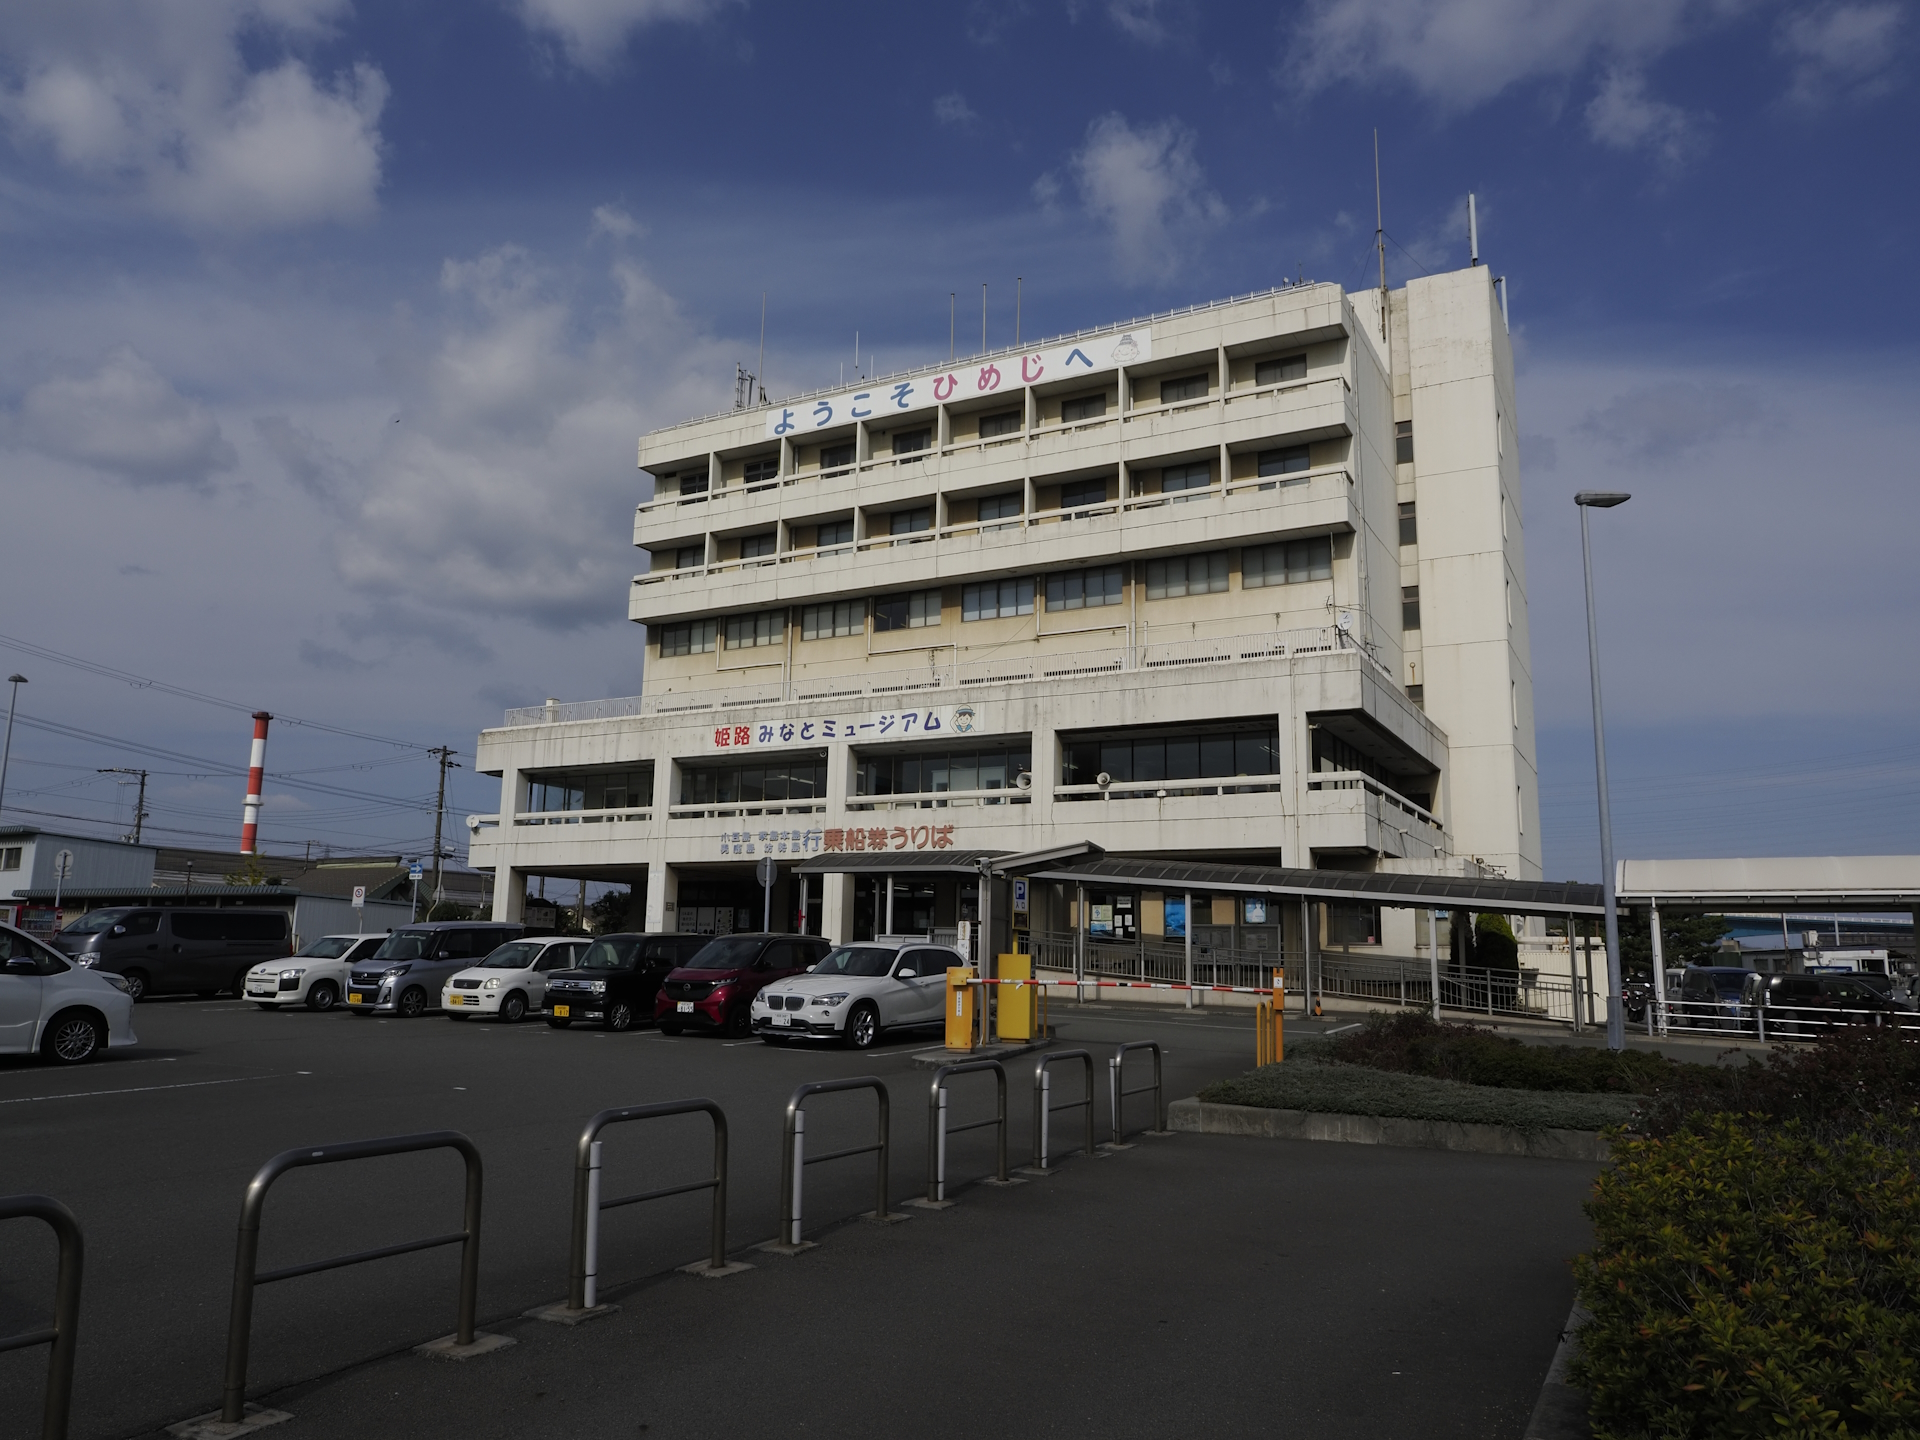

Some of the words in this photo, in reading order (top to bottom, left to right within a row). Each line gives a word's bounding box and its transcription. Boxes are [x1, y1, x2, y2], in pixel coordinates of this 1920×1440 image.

[773, 348, 1094, 435] ようこそひめじへ
[1016, 882, 1025, 899] P
